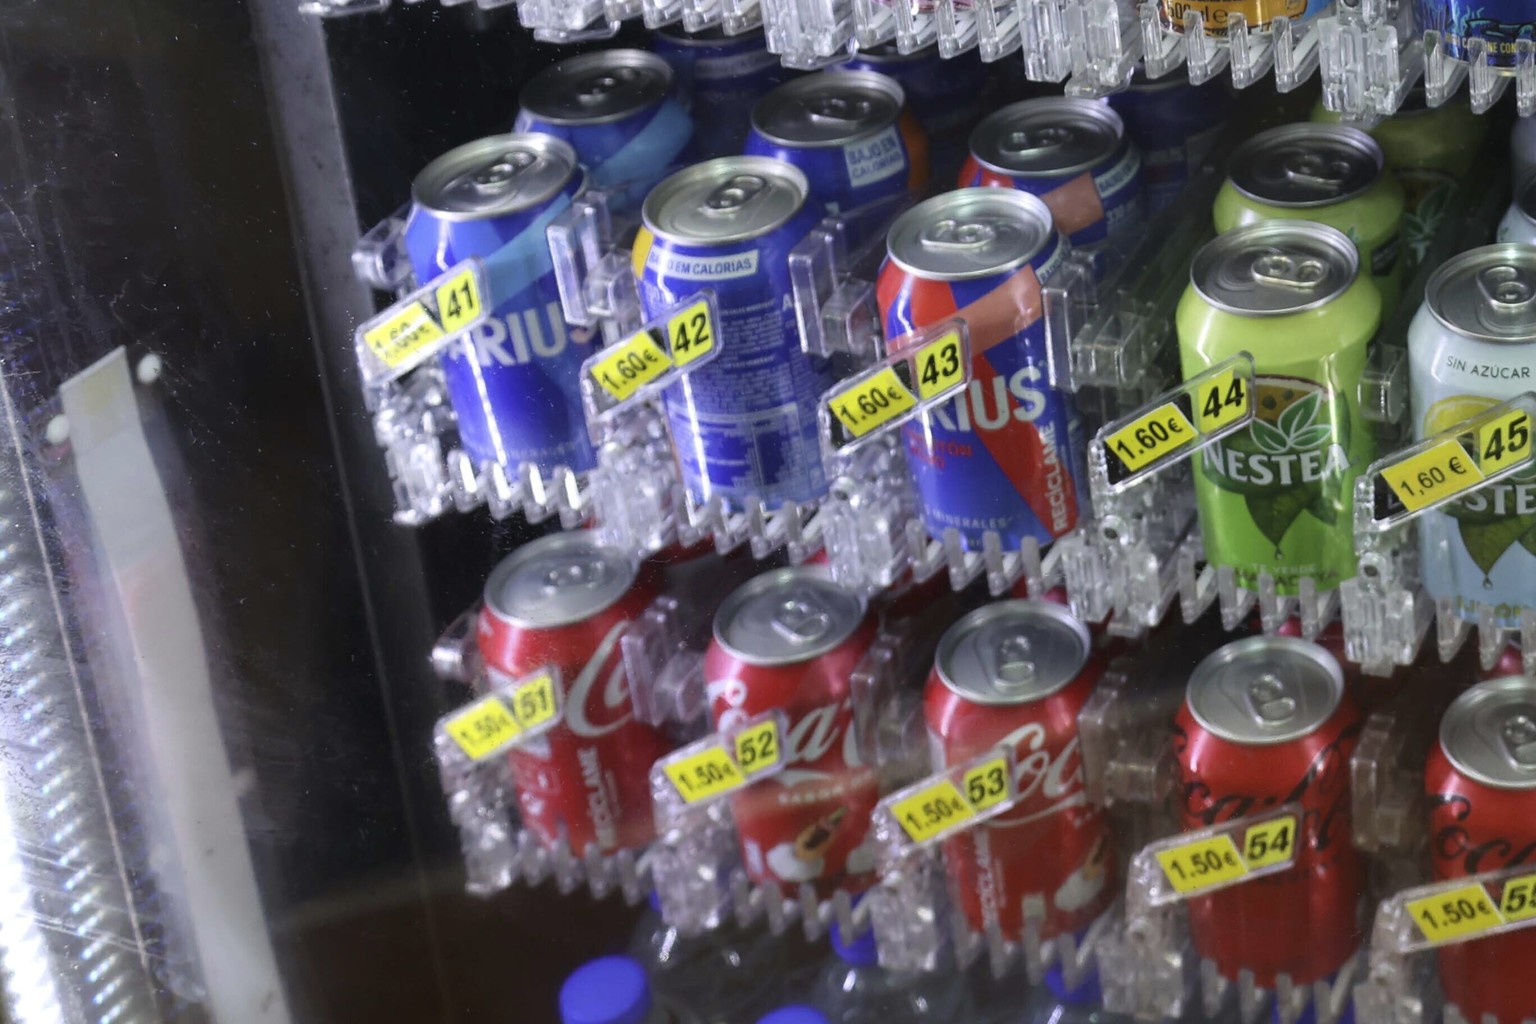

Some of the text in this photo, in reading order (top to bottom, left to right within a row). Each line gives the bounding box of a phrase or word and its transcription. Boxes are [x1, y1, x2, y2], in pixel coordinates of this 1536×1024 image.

[692, 258, 752, 276] CALORIAS
[446, 279, 476, 319] 41
[672, 312, 710, 354] 42
[601, 349, 659, 391] 1.60€
[921, 343, 961, 387] 43
[1446, 355, 1531, 380] SIN AZÚCAR
[840, 385, 903, 426] 1.60€
[1203, 378, 1245, 420] 44
[1116, 418, 1184, 461] 1.60€
[1483, 414, 1529, 463] 45
[1202, 440, 1351, 487] NESTEA
[1401, 465, 1446, 499] 1,60
[740, 730, 775, 766] 52
[678, 761, 735, 793] 1.50€
[968, 767, 1005, 806] 53
[905, 796, 965, 833] 1.50€
[1249, 825, 1290, 861] 54
[1170, 848, 1238, 881] 1.50€
[1421, 897, 1491, 931] 1.50€
